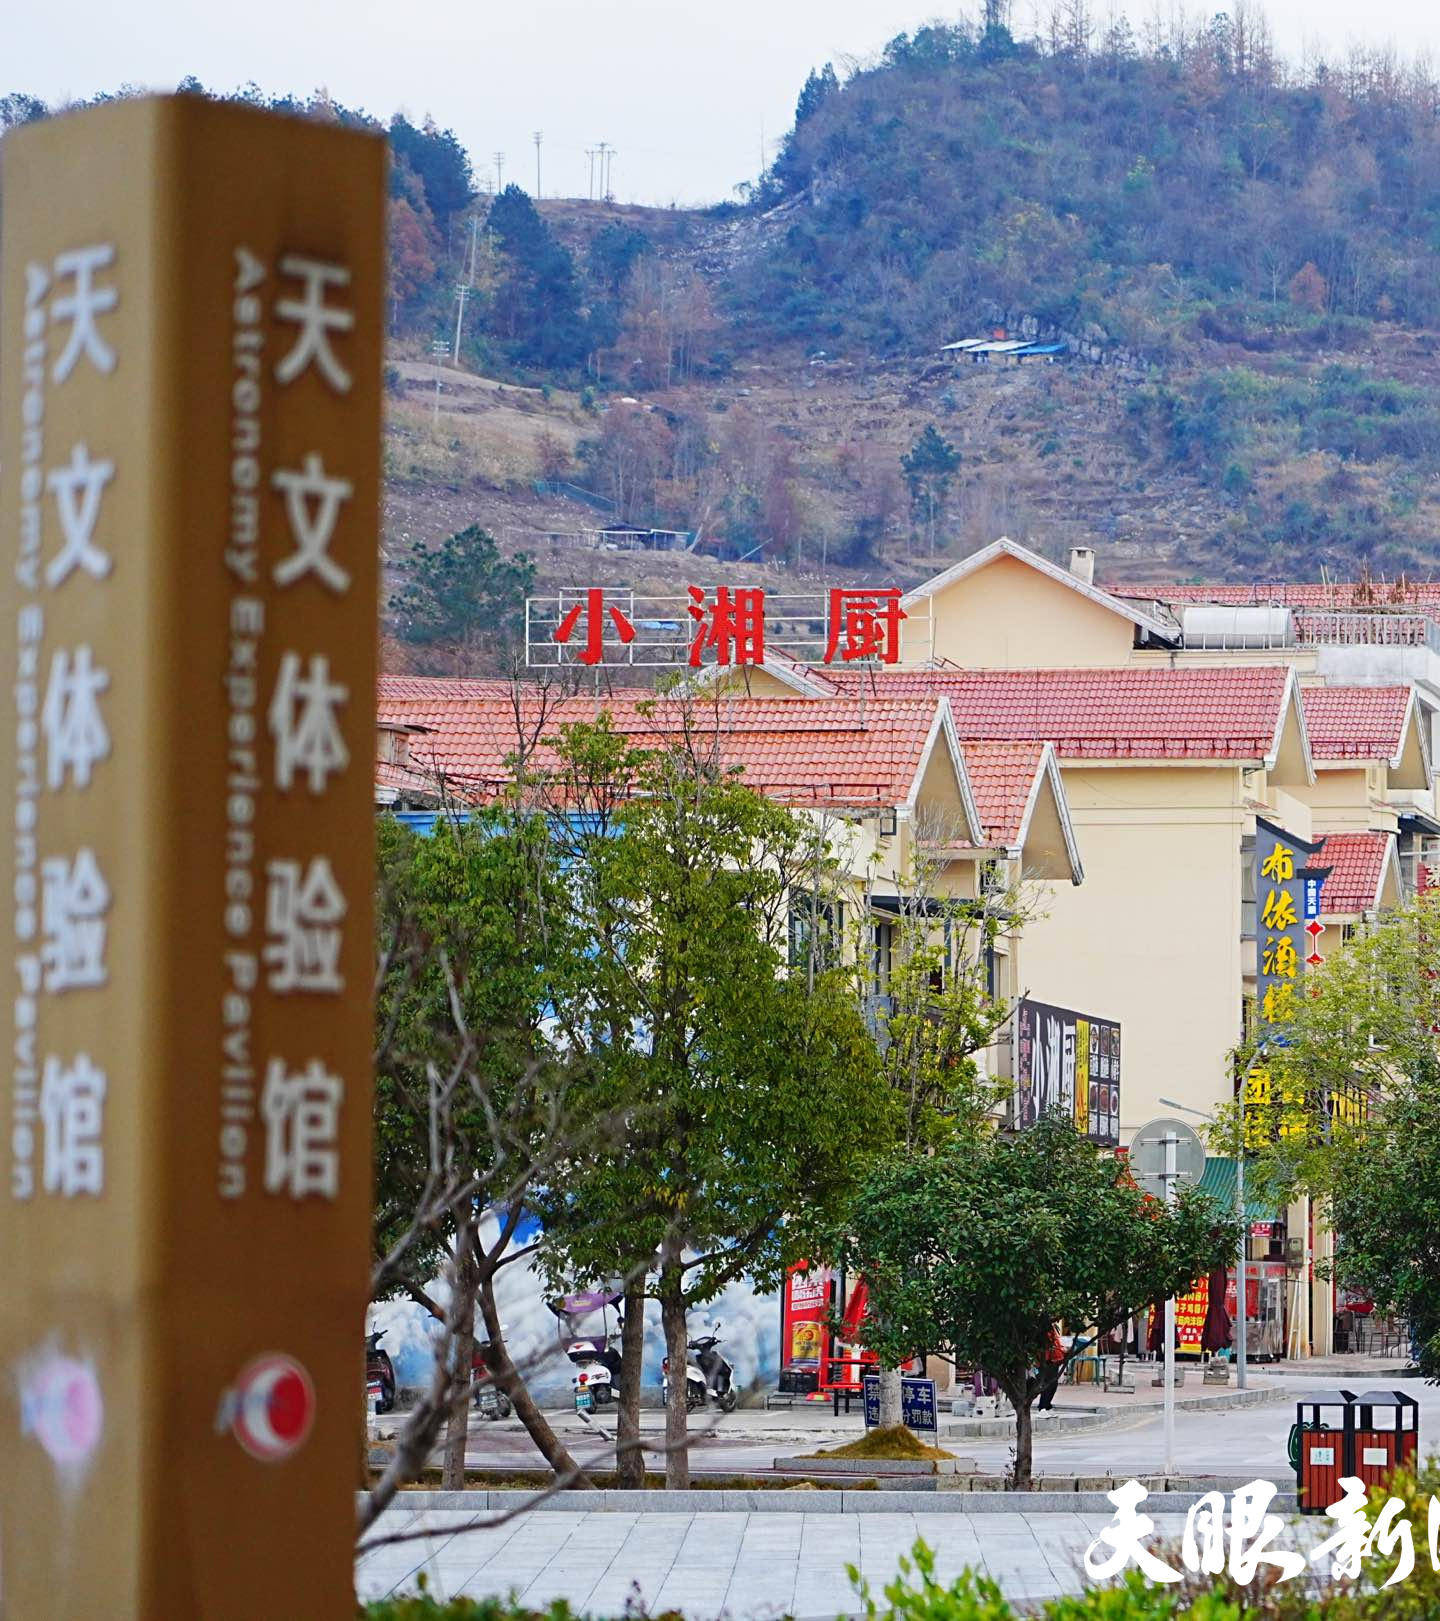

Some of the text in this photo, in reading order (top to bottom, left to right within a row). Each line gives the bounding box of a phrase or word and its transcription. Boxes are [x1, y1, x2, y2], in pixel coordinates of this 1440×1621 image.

[39, 242, 118, 1197] 天文体验馆
[219, 247, 267, 1197] Astronomy Experience Pavilion
[261, 254, 354, 1199] 天文体验馆
[554, 586, 908, 666] 小湘厨
[868, 1383, 931, 1404] 禁停车
